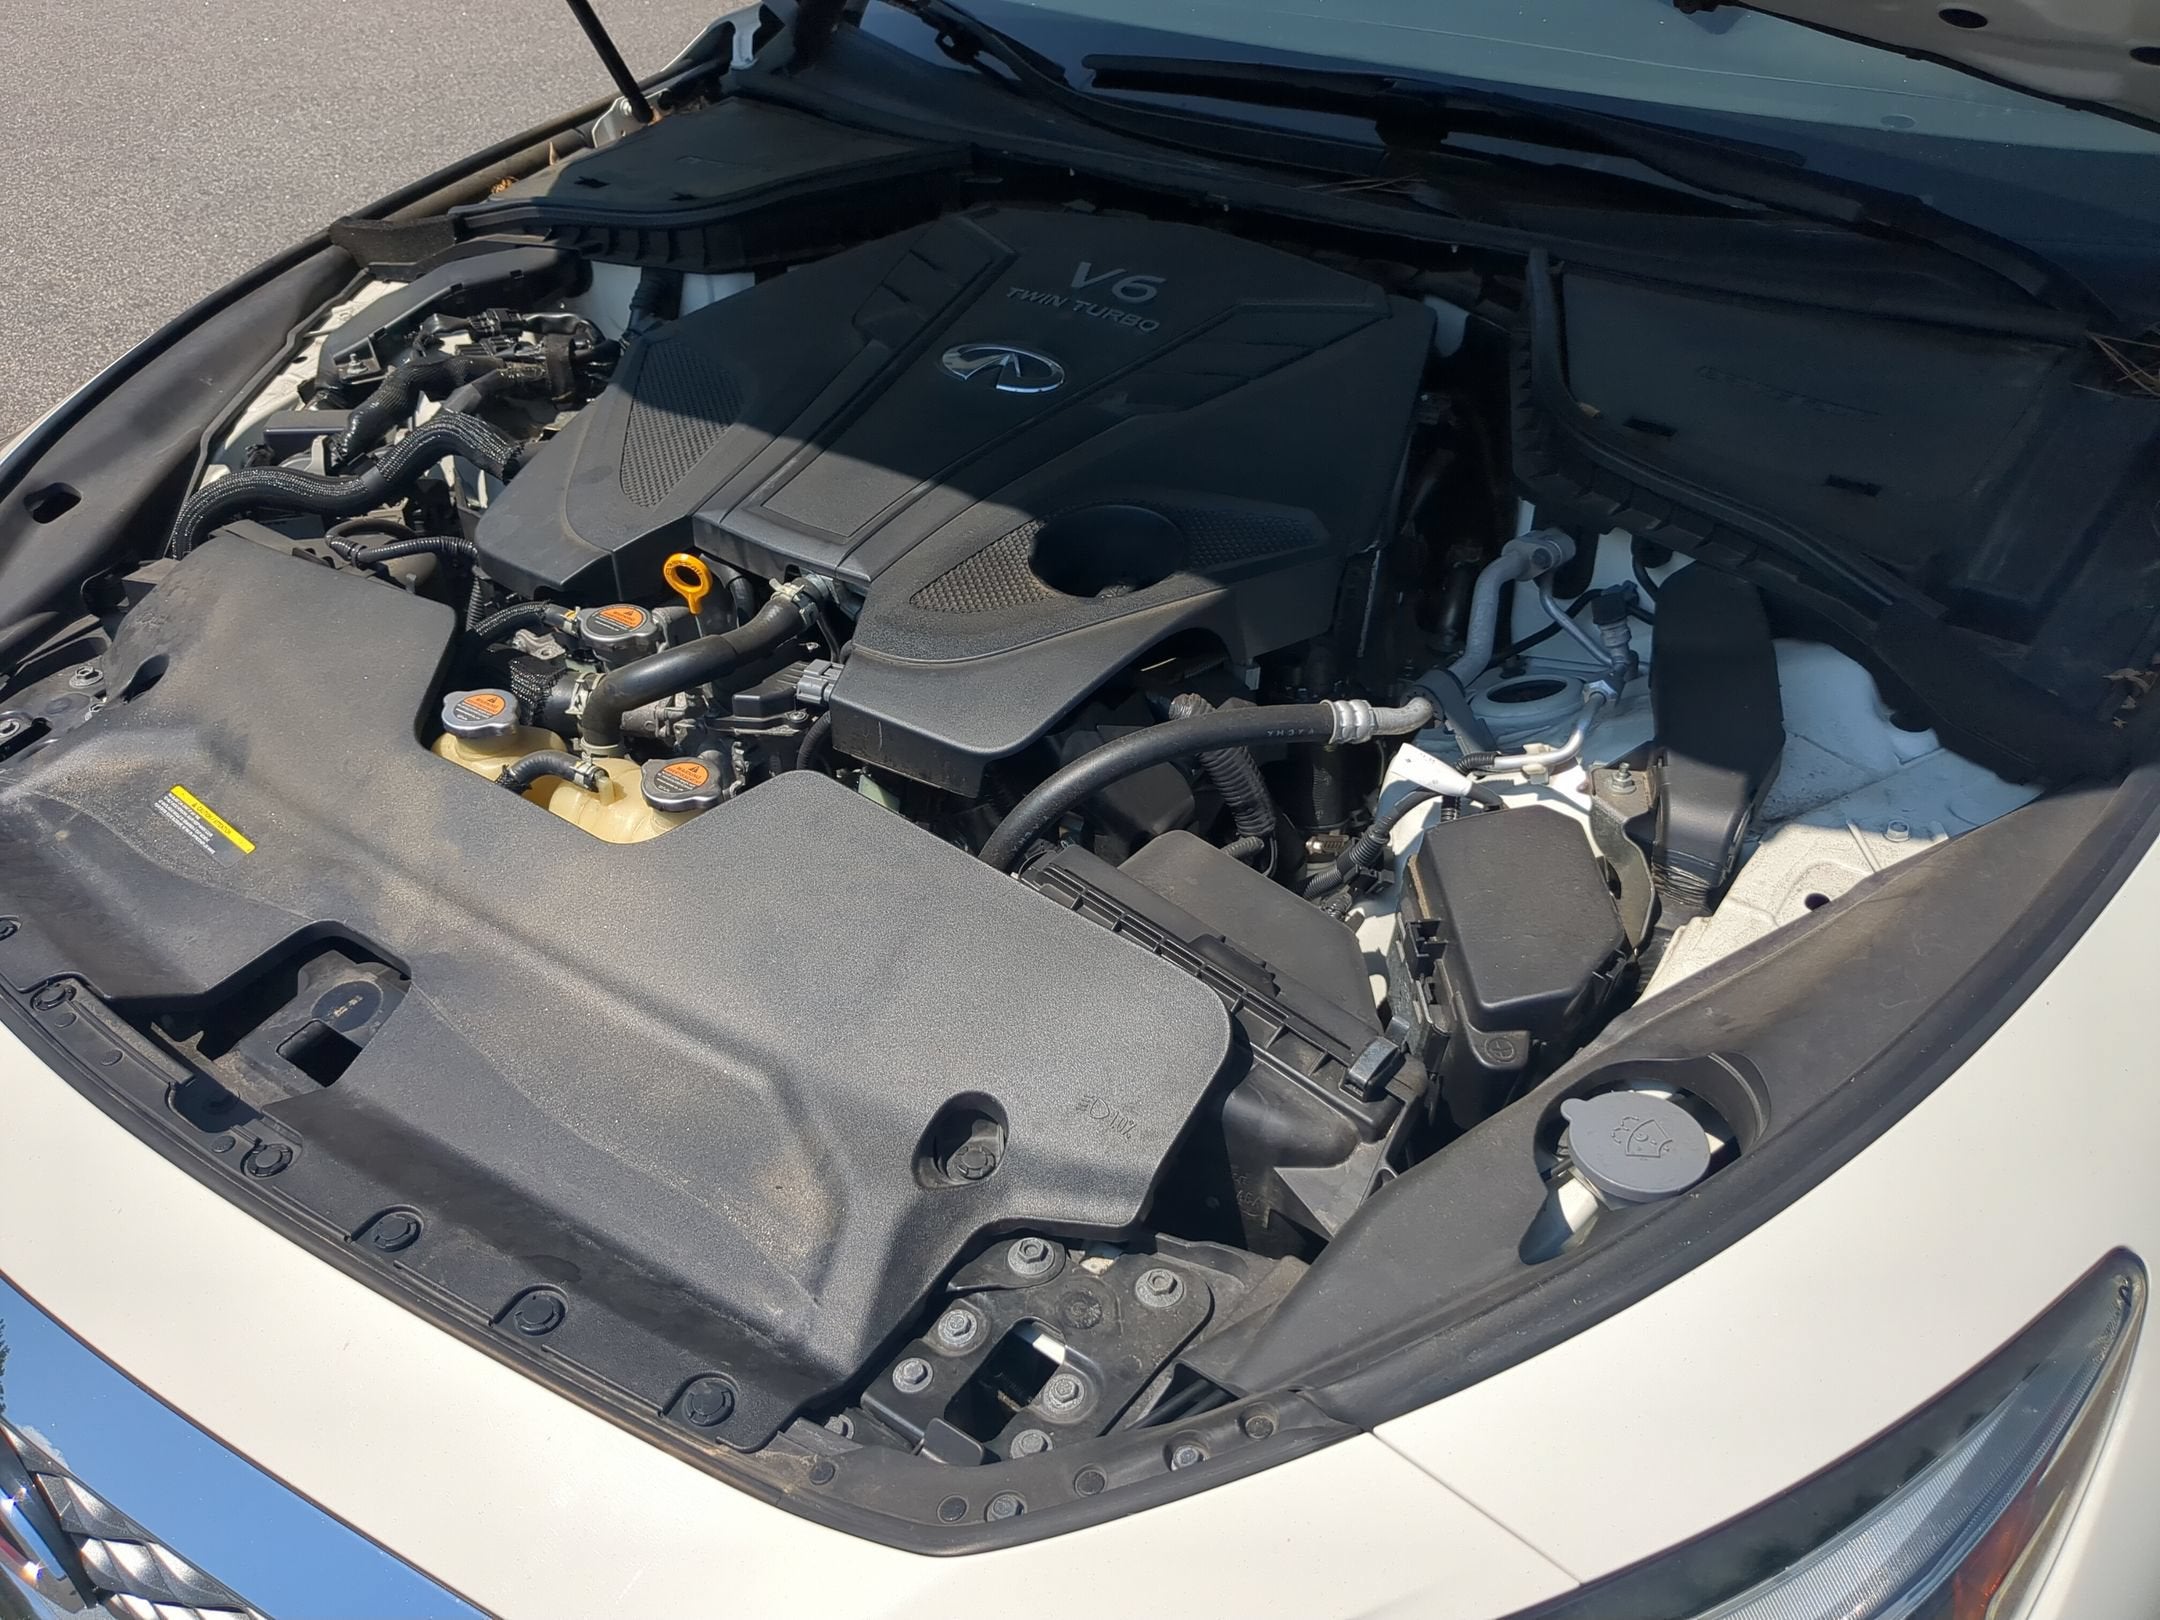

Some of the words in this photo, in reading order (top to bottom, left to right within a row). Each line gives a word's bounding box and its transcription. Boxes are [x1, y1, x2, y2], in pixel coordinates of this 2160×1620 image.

[1071, 261, 1167, 303] V6
[1006, 286, 1069, 308] TWIN
[1072, 299, 1160, 333] TURBO
